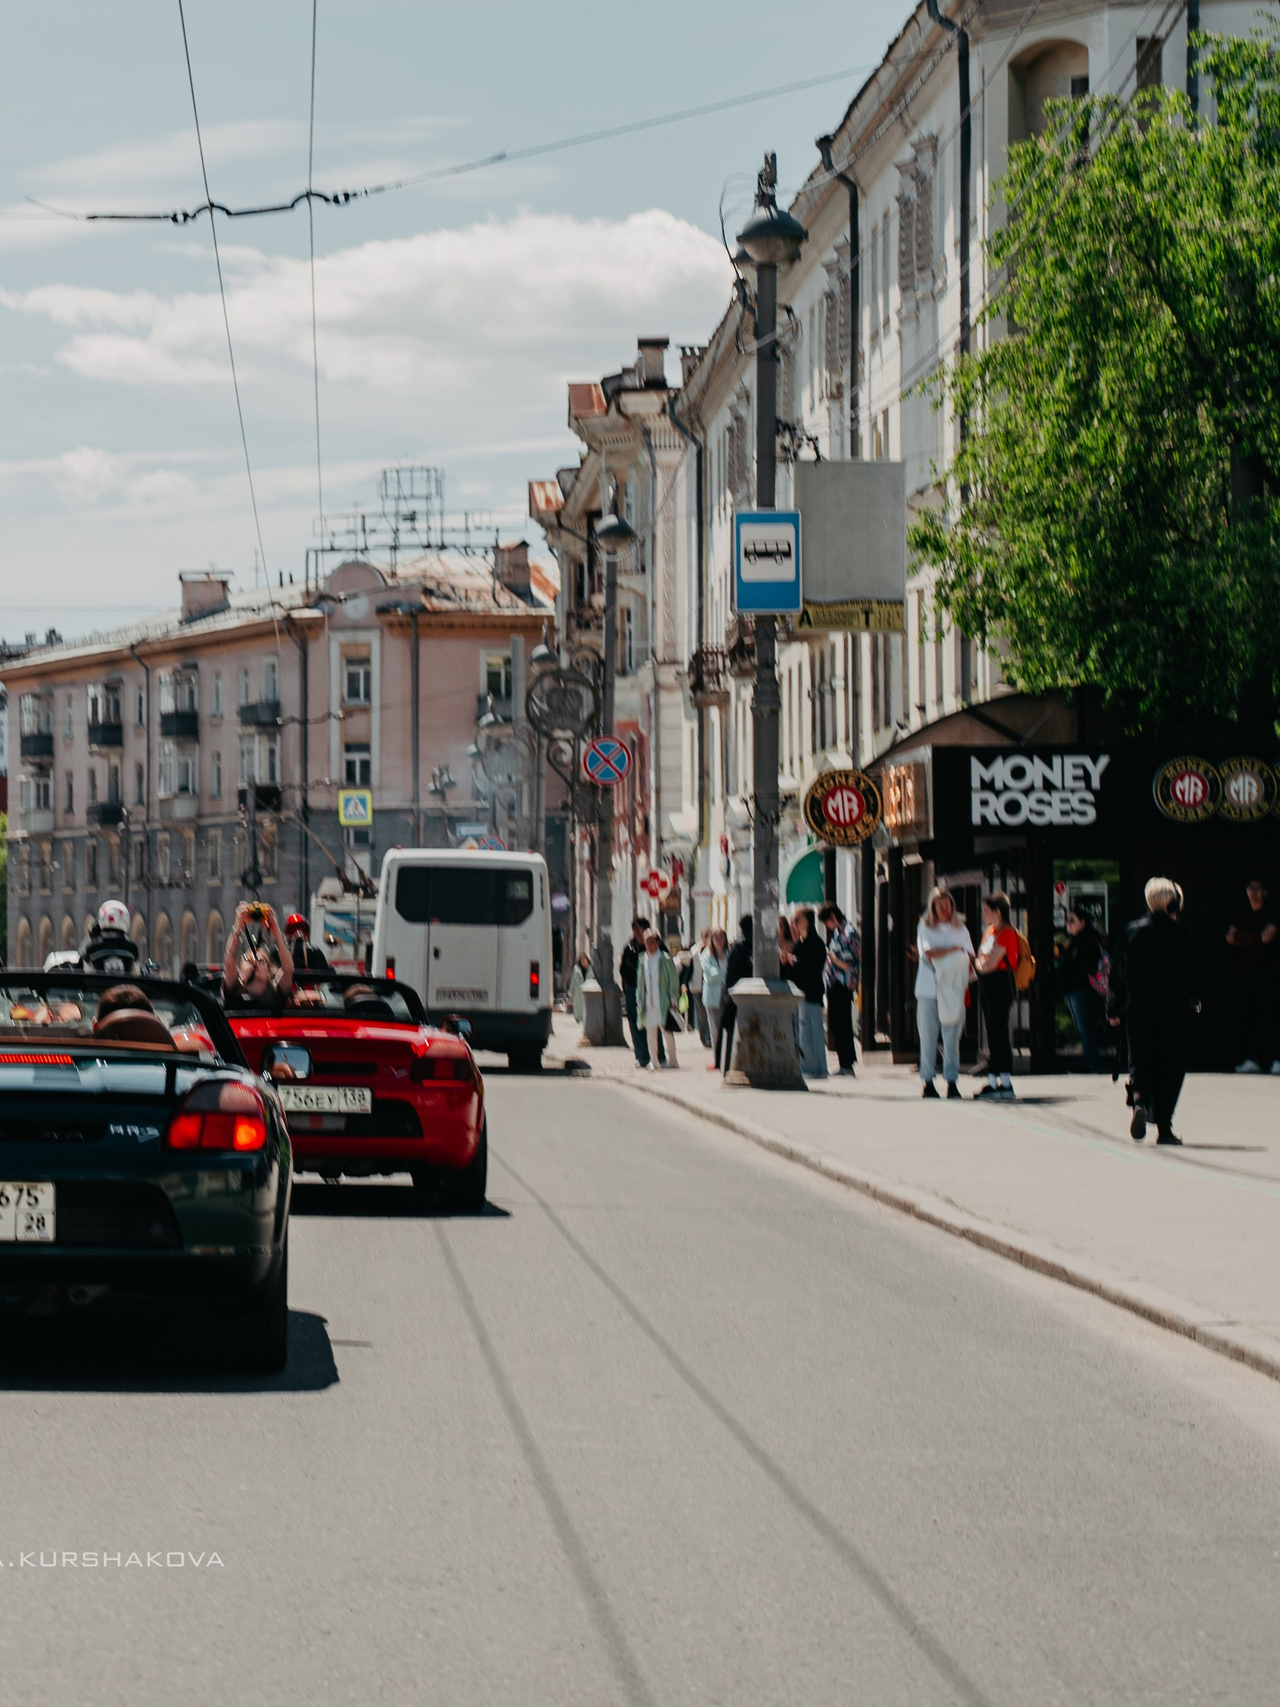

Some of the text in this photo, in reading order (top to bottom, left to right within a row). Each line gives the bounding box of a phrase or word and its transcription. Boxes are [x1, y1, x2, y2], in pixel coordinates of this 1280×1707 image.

[970, 754, 1111, 791] MONEY
[1175, 774, 1204, 805] MR
[827, 788, 860, 824] MR
[971, 789, 1098, 827] ROSES
[24, 1212, 46, 1232] 28
